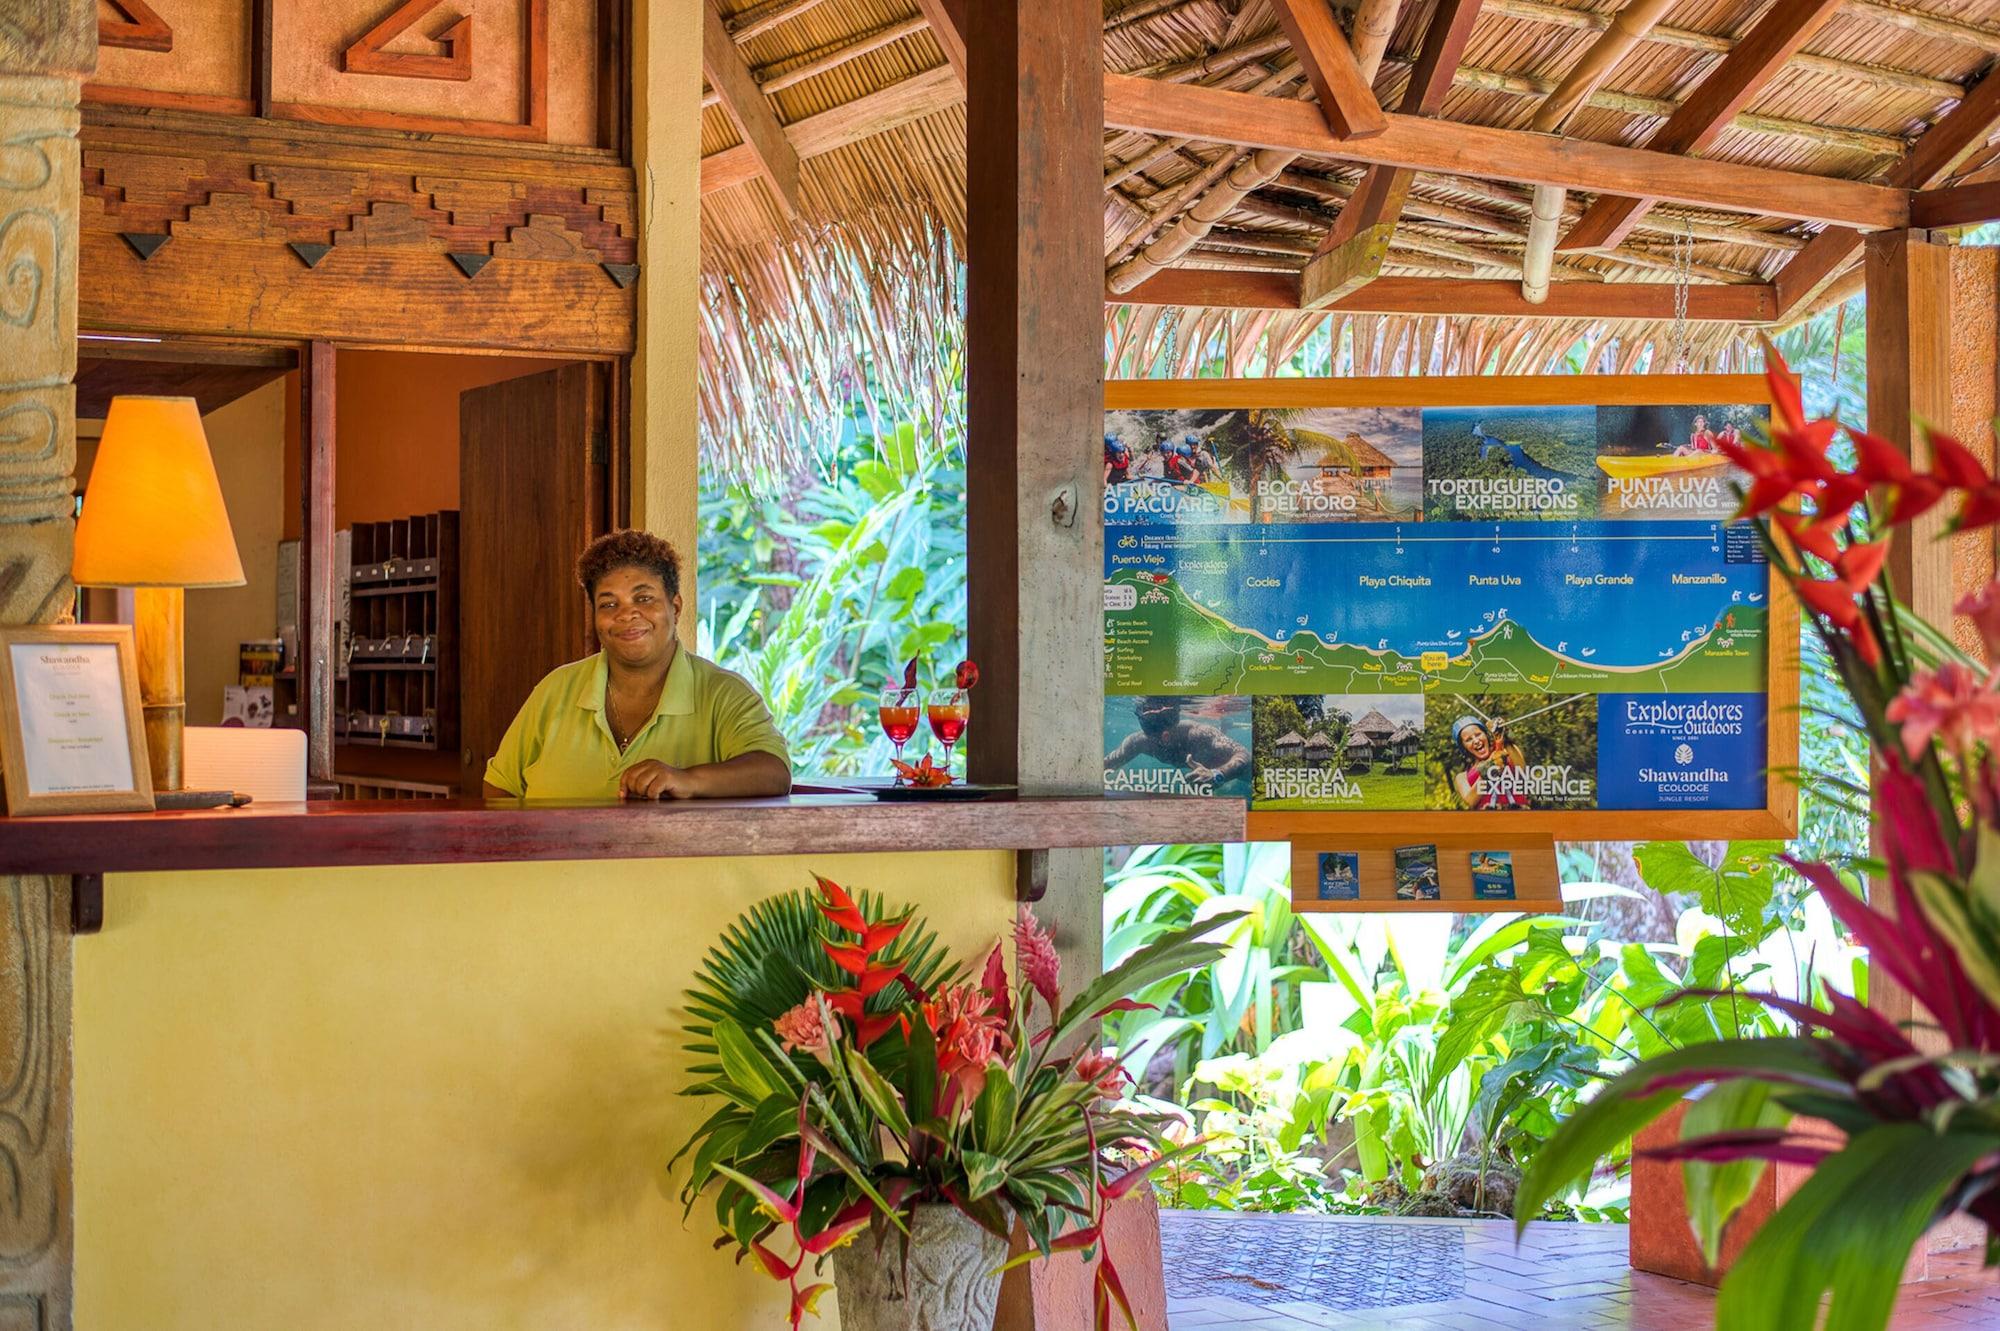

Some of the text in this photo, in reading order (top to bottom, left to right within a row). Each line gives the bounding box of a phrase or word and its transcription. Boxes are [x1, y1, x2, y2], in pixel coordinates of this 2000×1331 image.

[1104, 482, 1172, 498] AFTING
[1257, 480, 1324, 496] BOCAS
[1428, 478, 1564, 495] TORTUGUERO
[1608, 477, 1720, 493] PUNTA UVA
[1104, 497, 1214, 513] O PACUARE
[1263, 496, 1357, 512] DEL TORO
[1455, 494, 1578, 510] EXPEDITIONS
[1620, 493, 1717, 508] KAYAKING
[1112, 555, 1165, 566] Puerto Viejo
[1246, 577, 1281, 587] Cocles
[1360, 575, 1431, 589] Playa Chiquita
[1469, 575, 1521, 586] Punta Uva
[1566, 574, 1634, 587] Playa Grande
[1672, 573, 1727, 585] Manzanillo
[40, 656, 90, 664] Shawandha
[1626, 700, 1743, 726] Exploradores
[1683, 720, 1742, 735] Outdoors
[1104, 769, 1186, 784] CAHUITA
[1263, 768, 1345, 783] RESERVA
[1487, 765, 1572, 782] CANOPY
[1638, 768, 1728, 782] Shawandha
[1265, 783, 1363, 798] INDIGENA
[1476, 780, 1590, 795] EXPERIENCE
[1658, 784, 1709, 792] ECOLODGE
